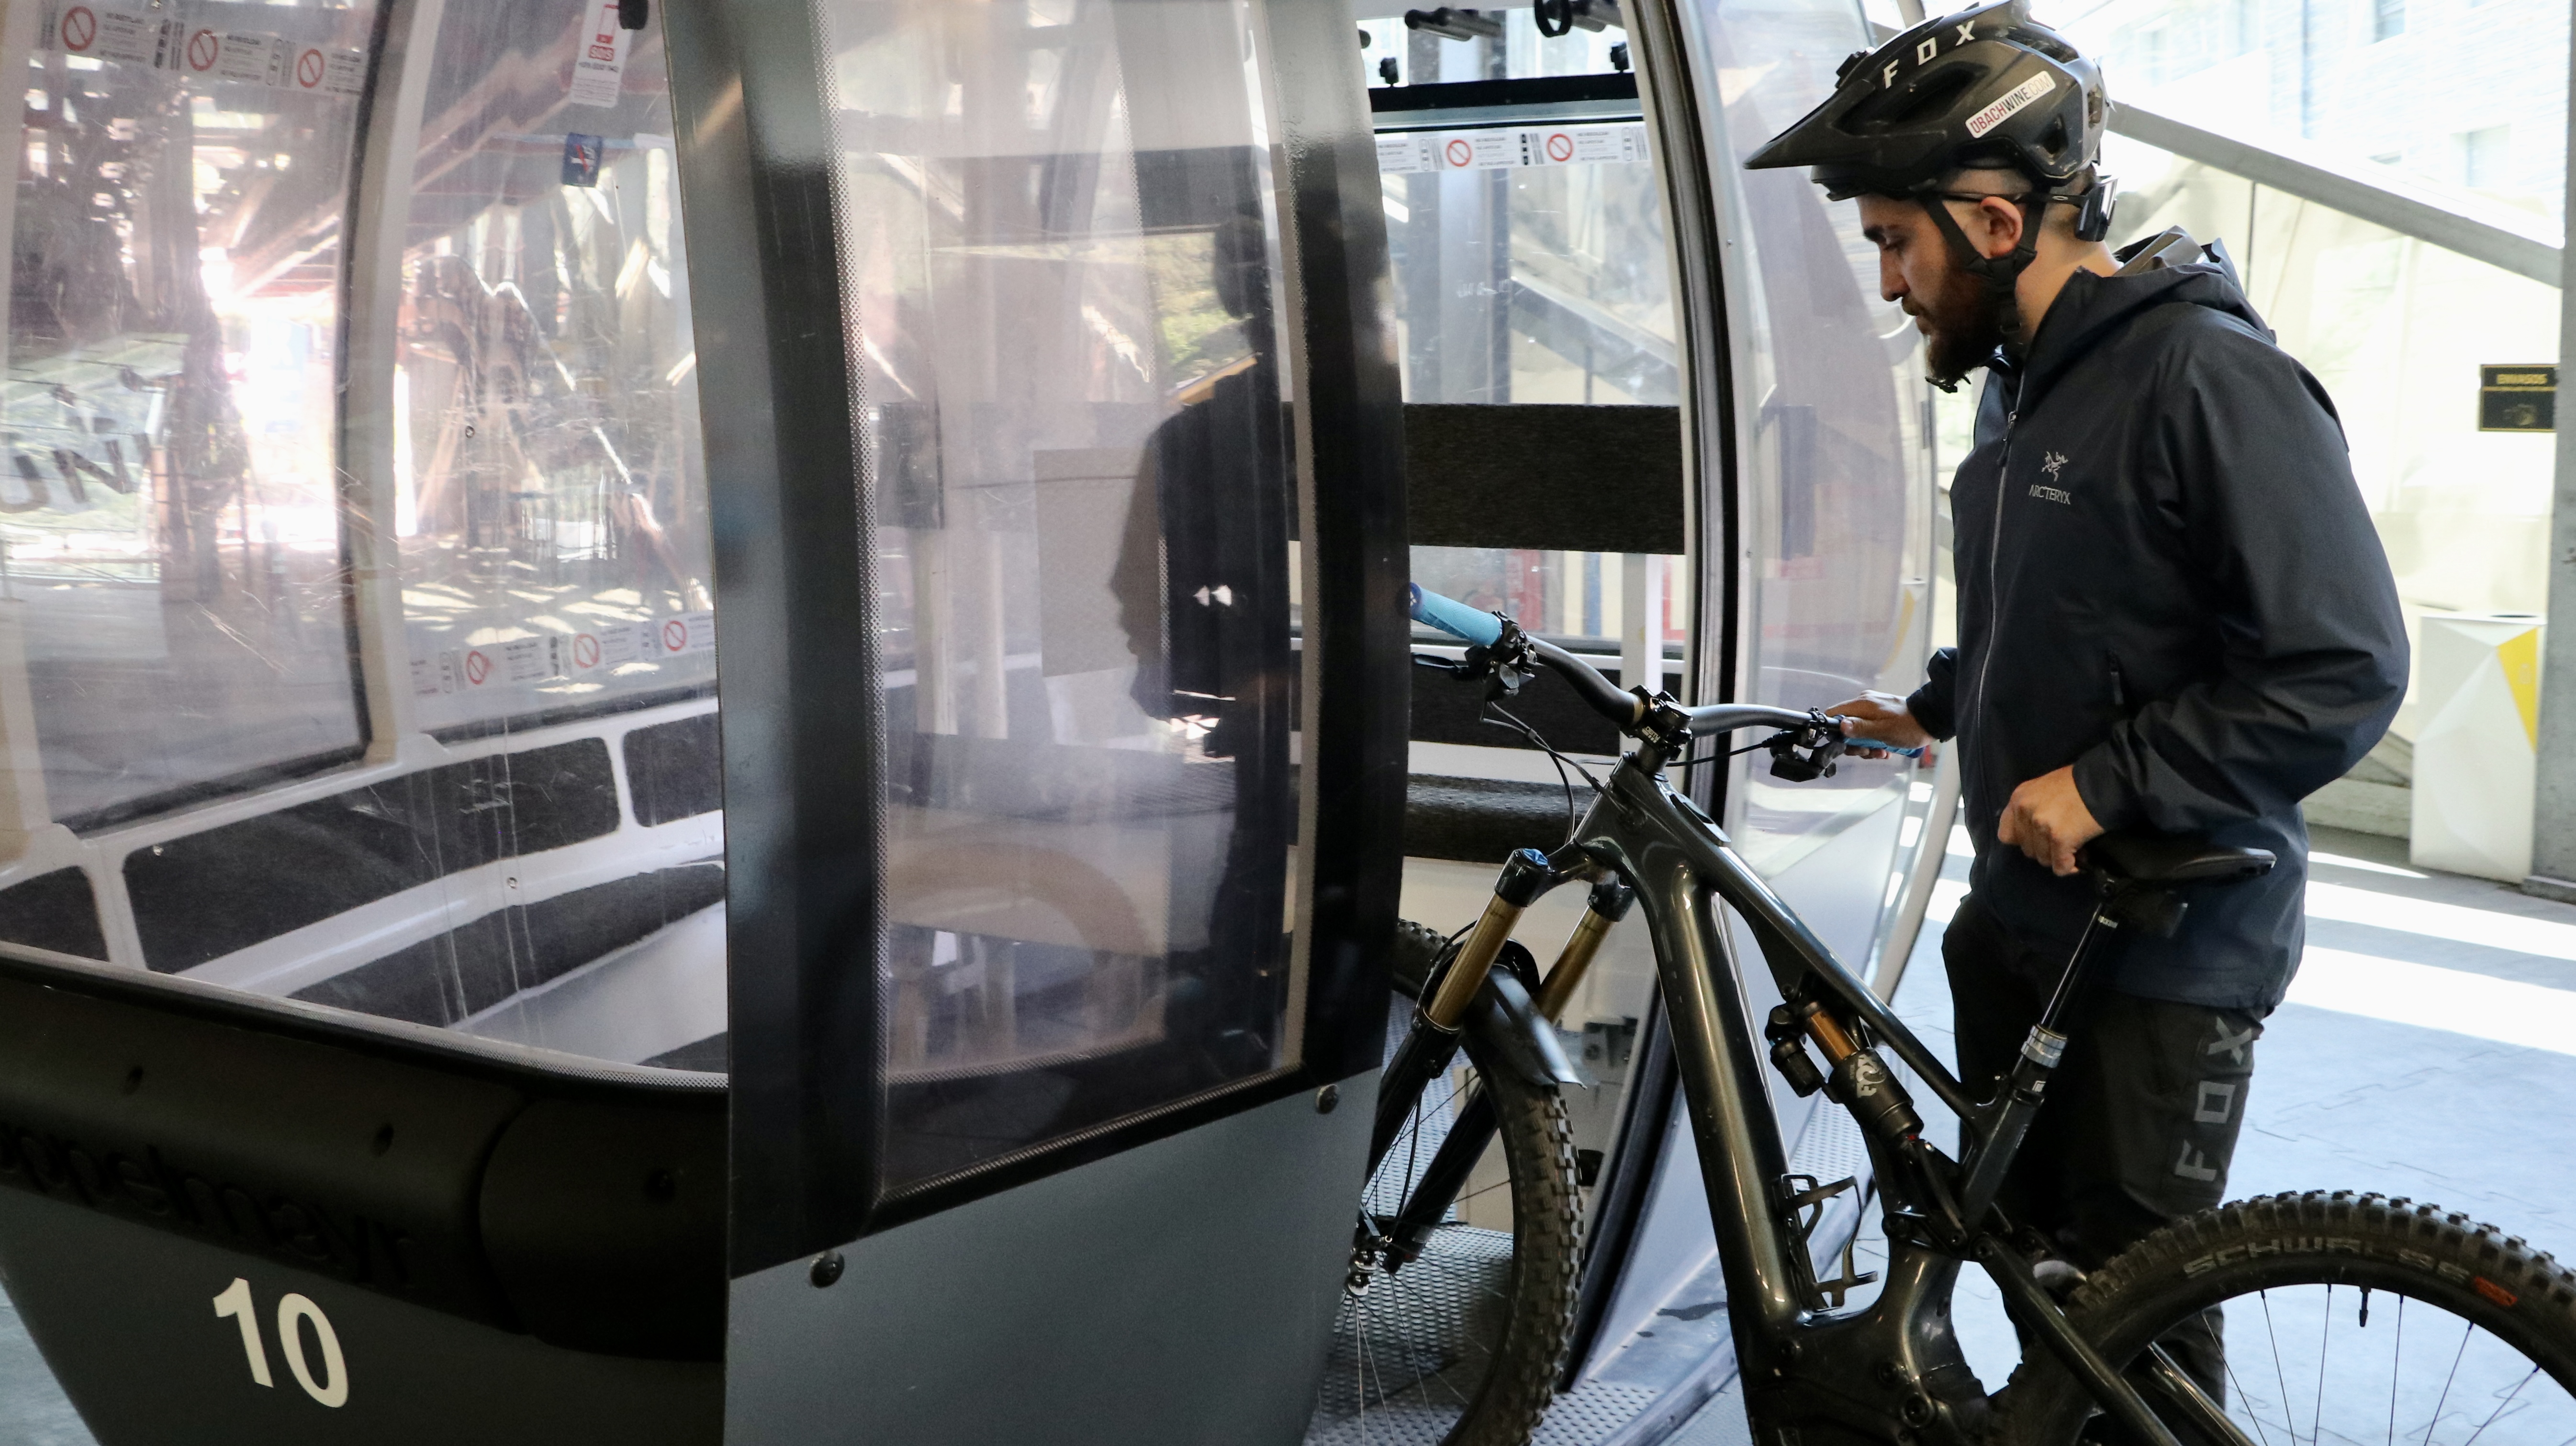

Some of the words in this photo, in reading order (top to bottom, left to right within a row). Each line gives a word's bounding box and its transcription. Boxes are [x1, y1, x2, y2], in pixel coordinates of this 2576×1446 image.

[1883, 20, 1976, 90] FOX
[1970, 74, 2052, 134] UBACHWINE.COM
[1645, 726, 1661, 741] DEITY
[1856, 1054, 1886, 1099] FOX
[2174, 1015, 2252, 1182] FOX
[213, 1277, 349, 1409] 10
